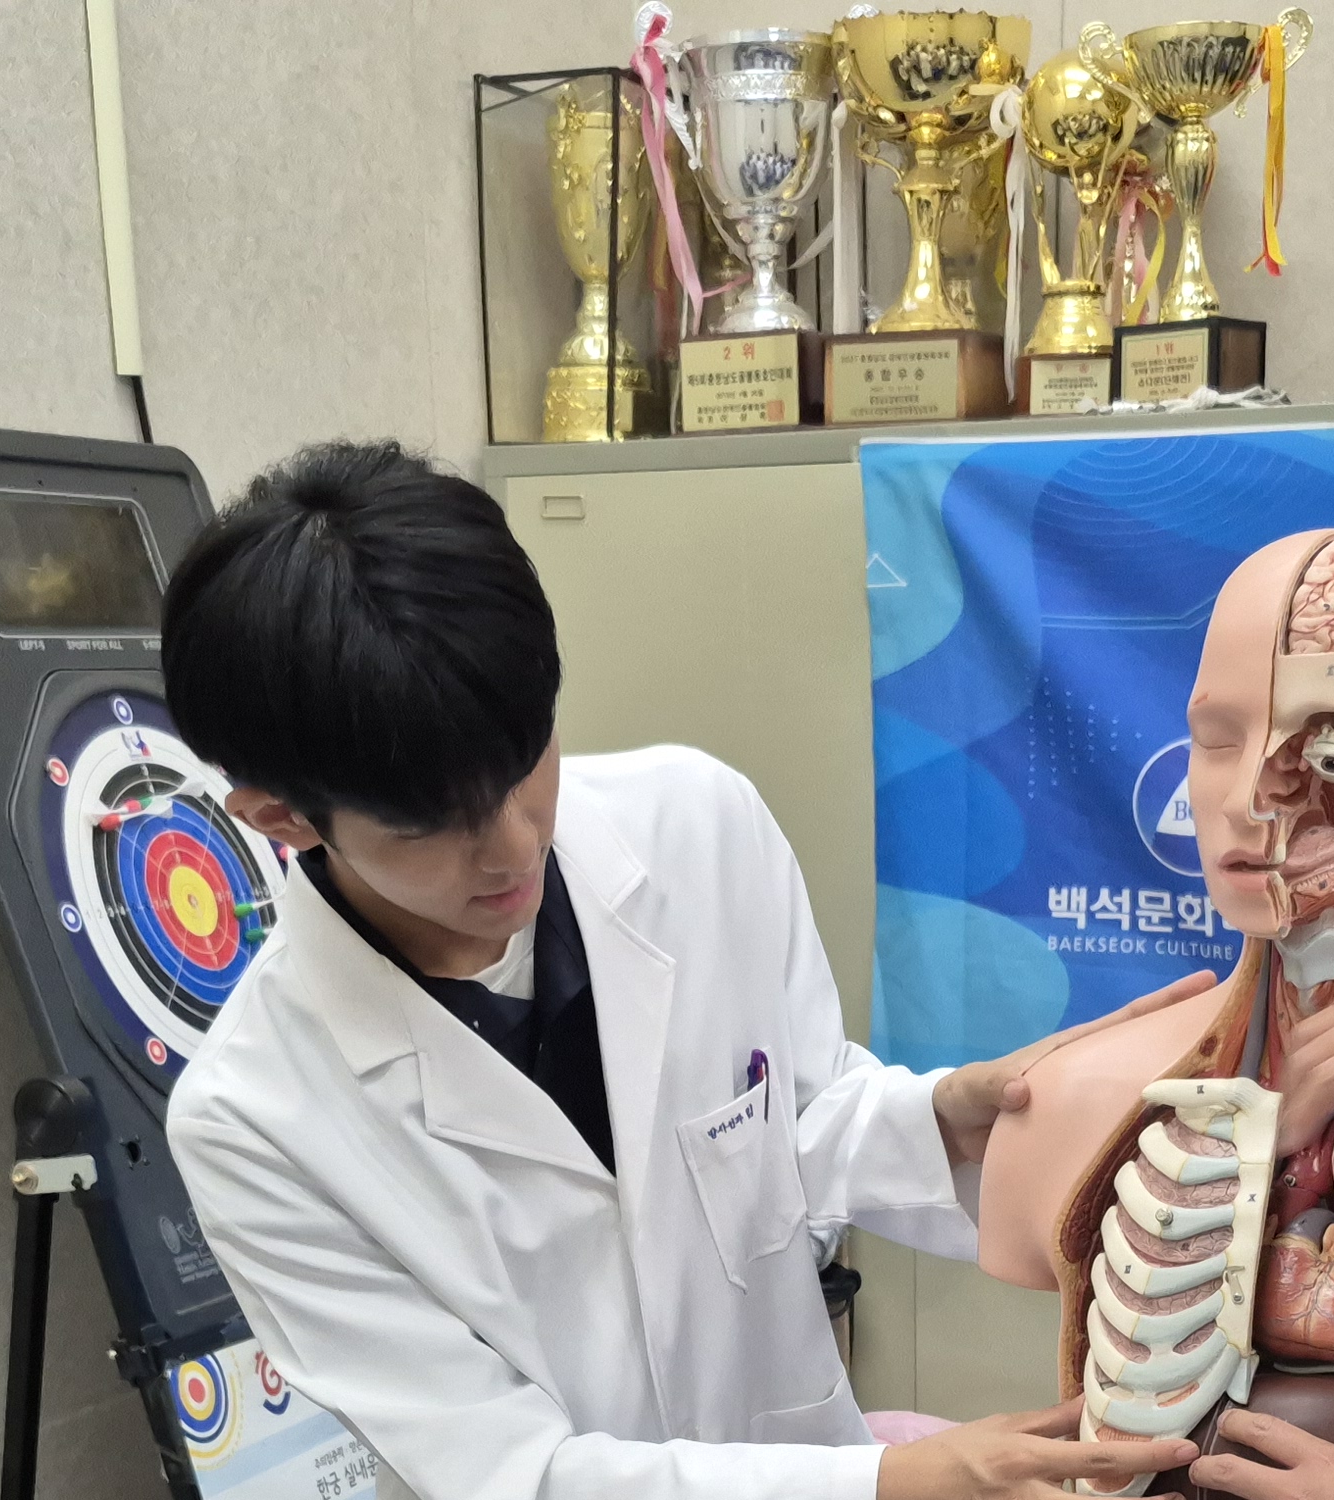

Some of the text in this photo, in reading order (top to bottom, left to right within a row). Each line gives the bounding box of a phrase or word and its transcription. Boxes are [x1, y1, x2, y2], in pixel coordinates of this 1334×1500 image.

[1048, 887, 1239, 937] 백석문화
[1048, 936, 1234, 961] BAEKSEOK CULTURE
[317, 1452, 378, 1500] 한궁 실내운
